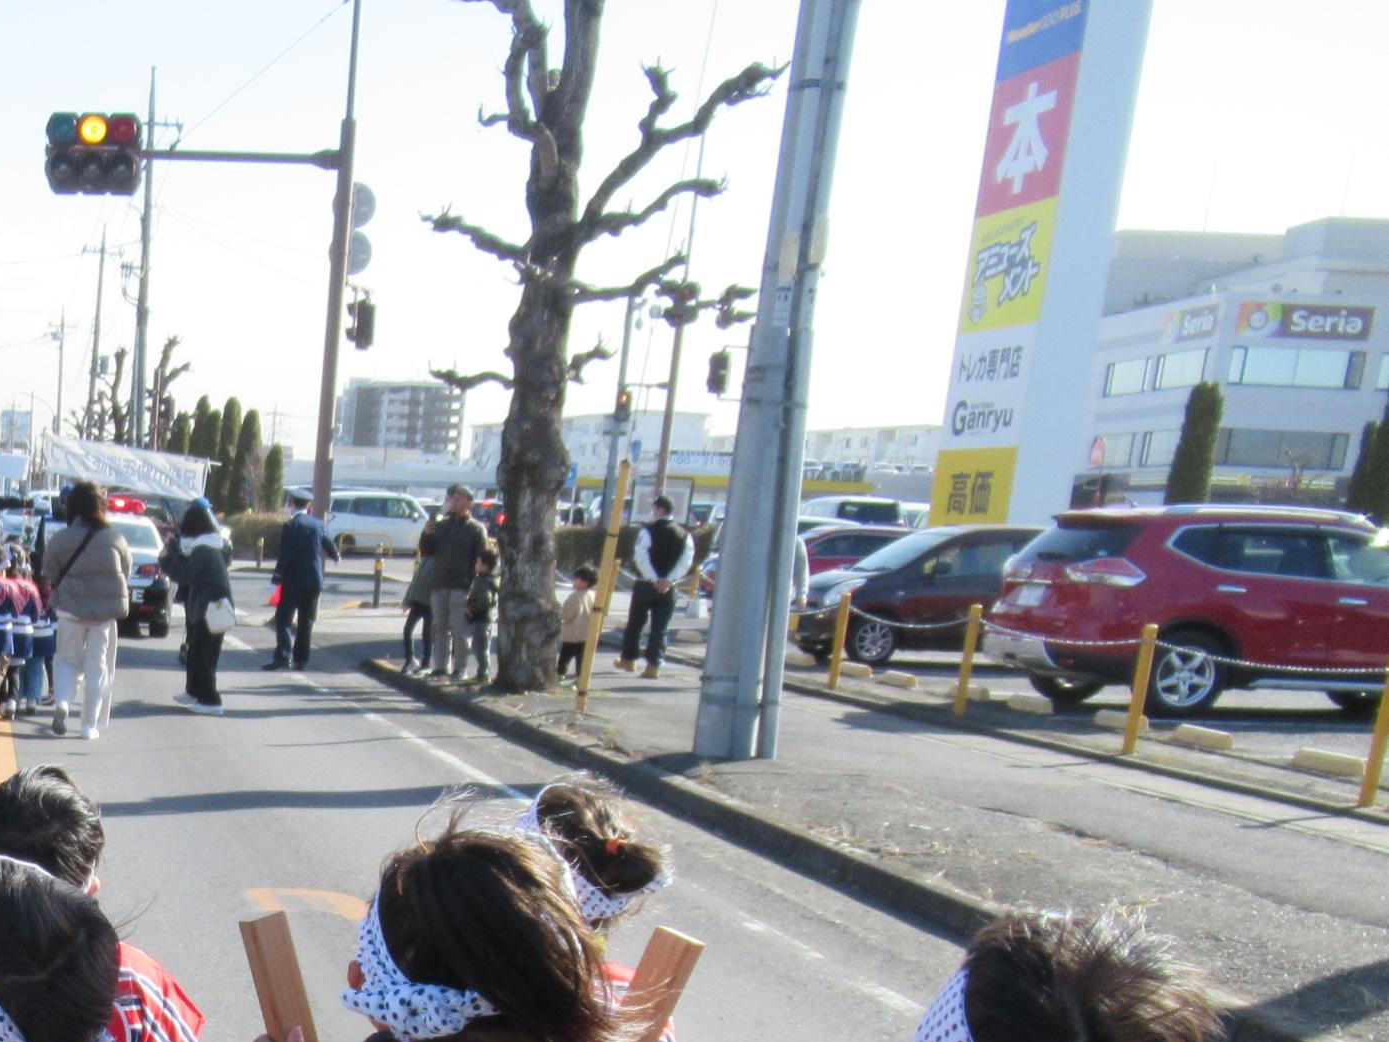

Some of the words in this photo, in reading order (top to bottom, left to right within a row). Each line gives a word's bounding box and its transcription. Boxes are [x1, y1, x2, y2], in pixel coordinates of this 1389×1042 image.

[996, 81, 1058, 195] 本
[1181, 309, 1215, 336] Seria
[1290, 310, 1363, 335] Seria
[957, 344, 1024, 382] トレカ専門店
[951, 399, 1014, 436] Ganryu
[946, 470, 994, 516] 高価
